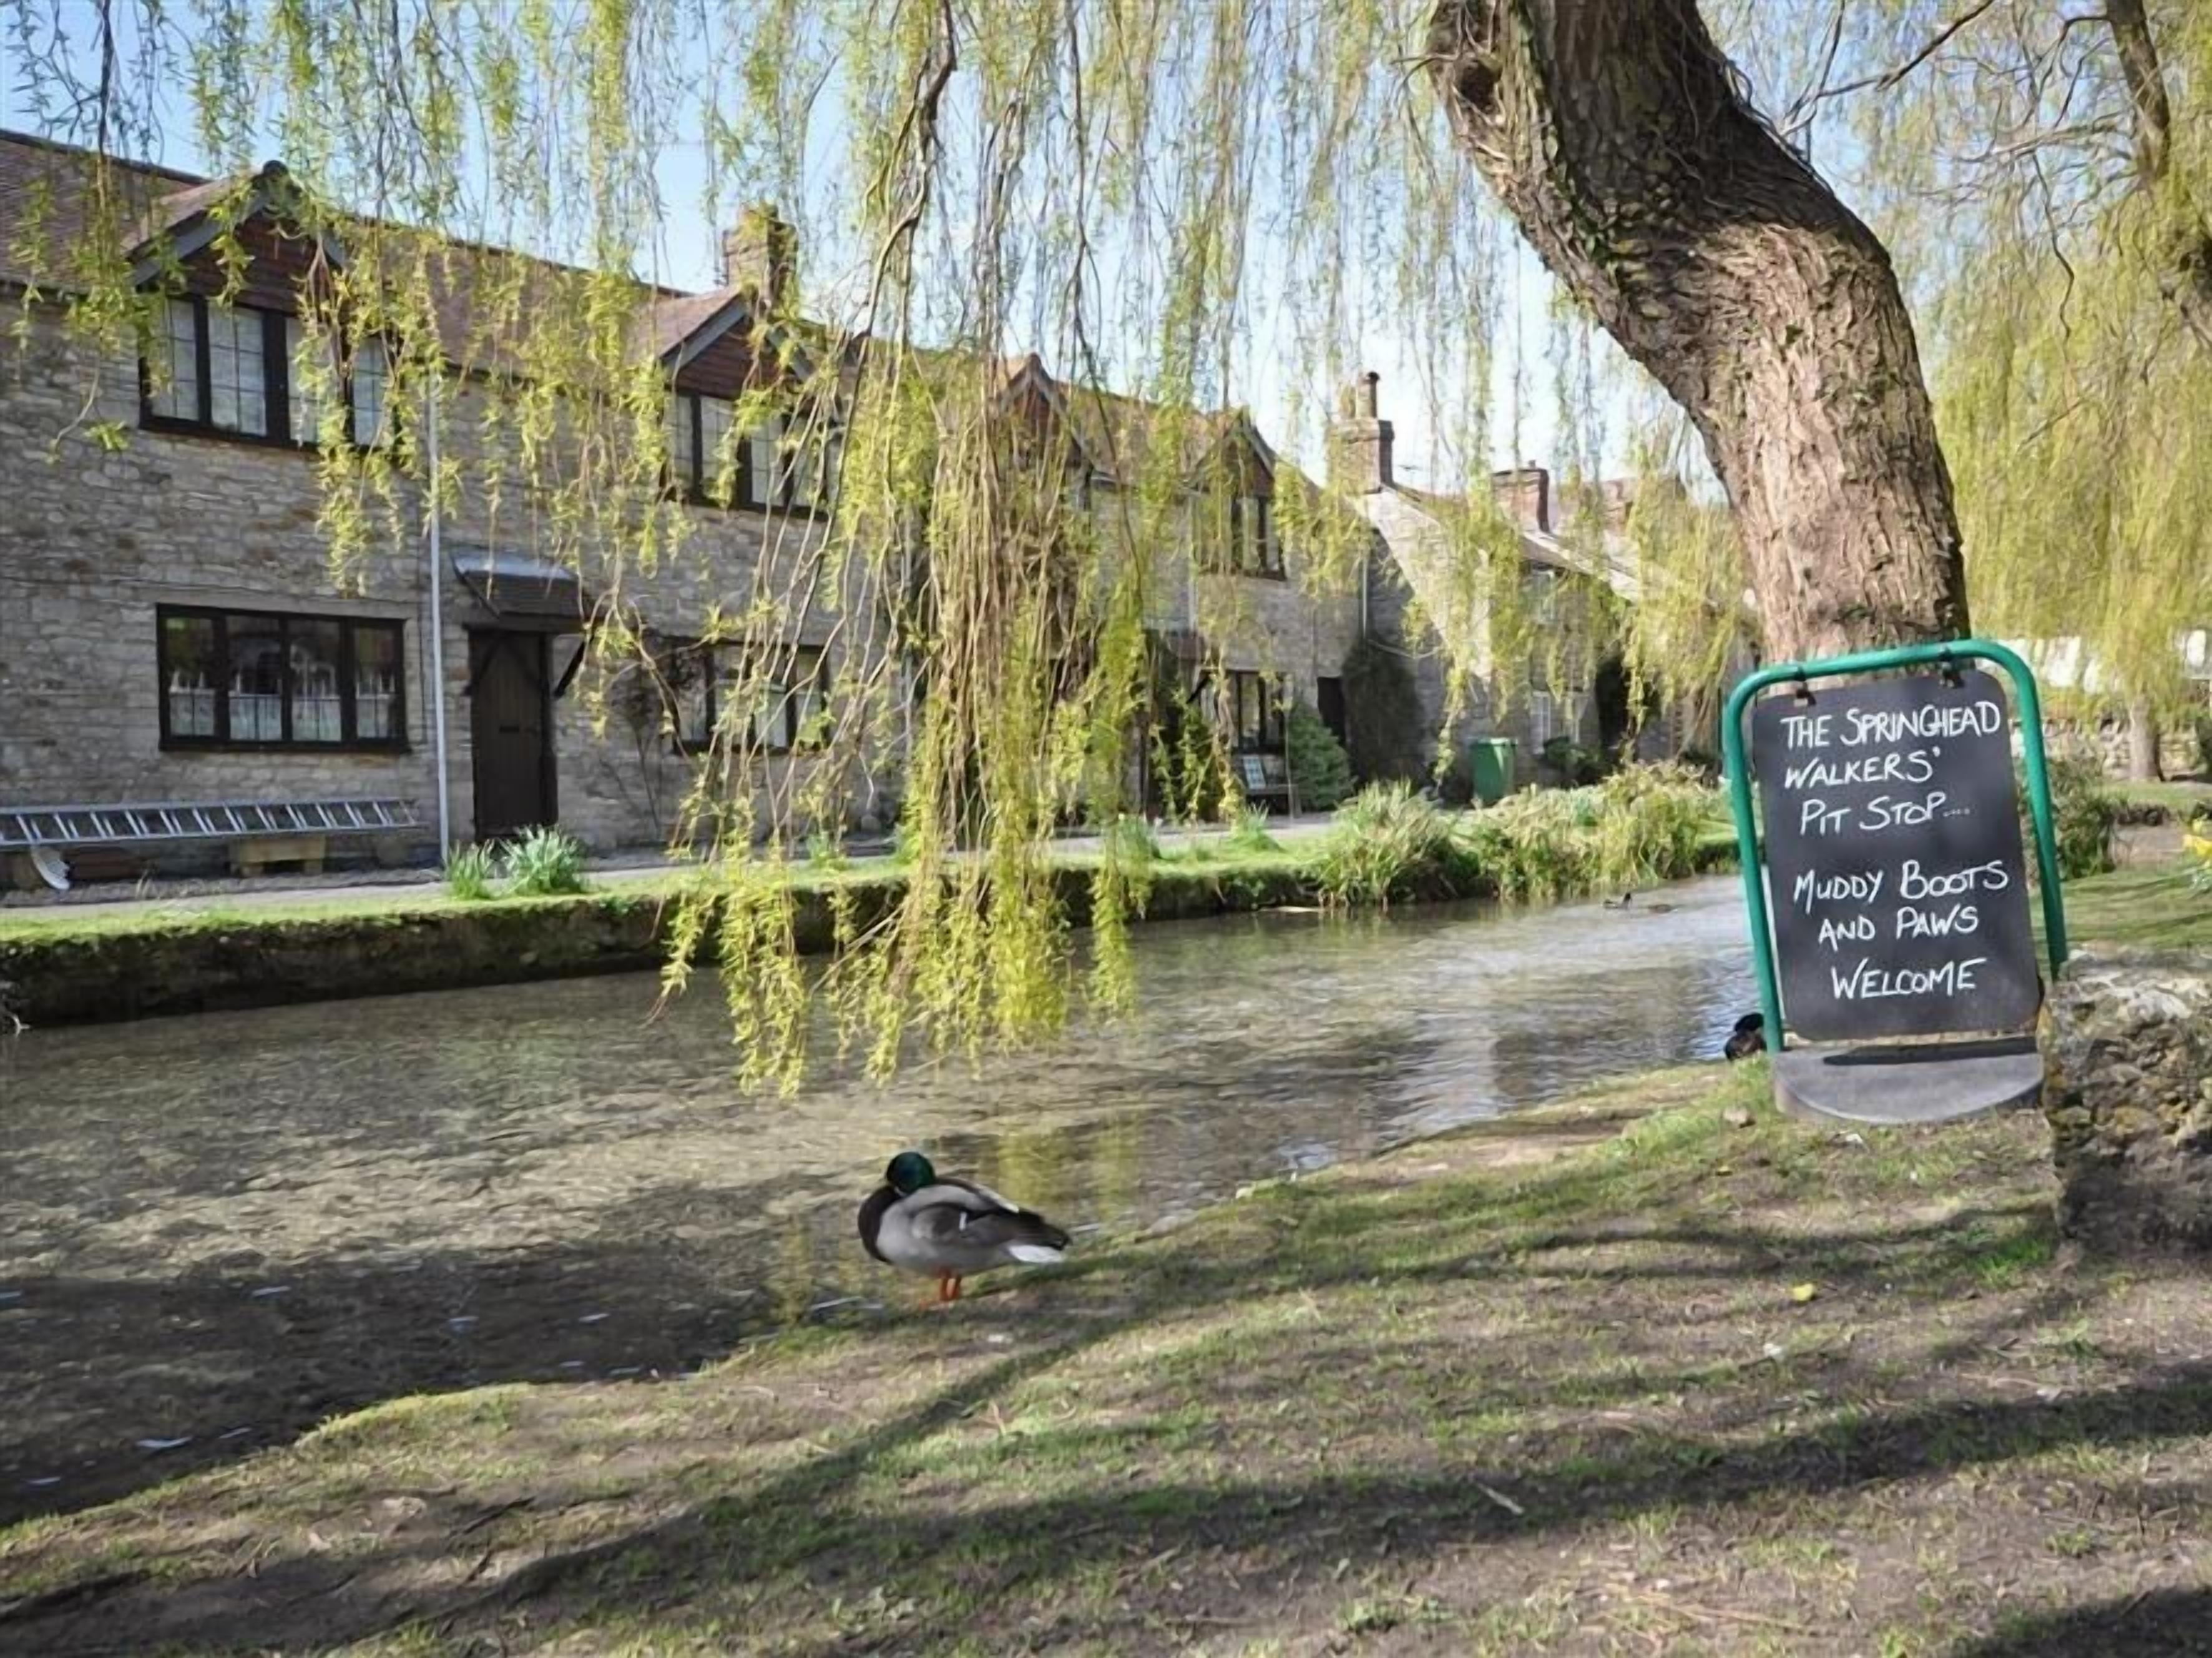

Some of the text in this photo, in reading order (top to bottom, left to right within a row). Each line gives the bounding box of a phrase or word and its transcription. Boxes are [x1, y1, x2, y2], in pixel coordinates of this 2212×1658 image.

[1780, 701, 2000, 749] THE SPRINGHEAD
[1793, 860, 2009, 915] MUDDY BOOTS
[1818, 903, 1979, 951] AND PAWS
[1831, 957, 1987, 999] WELCOME
